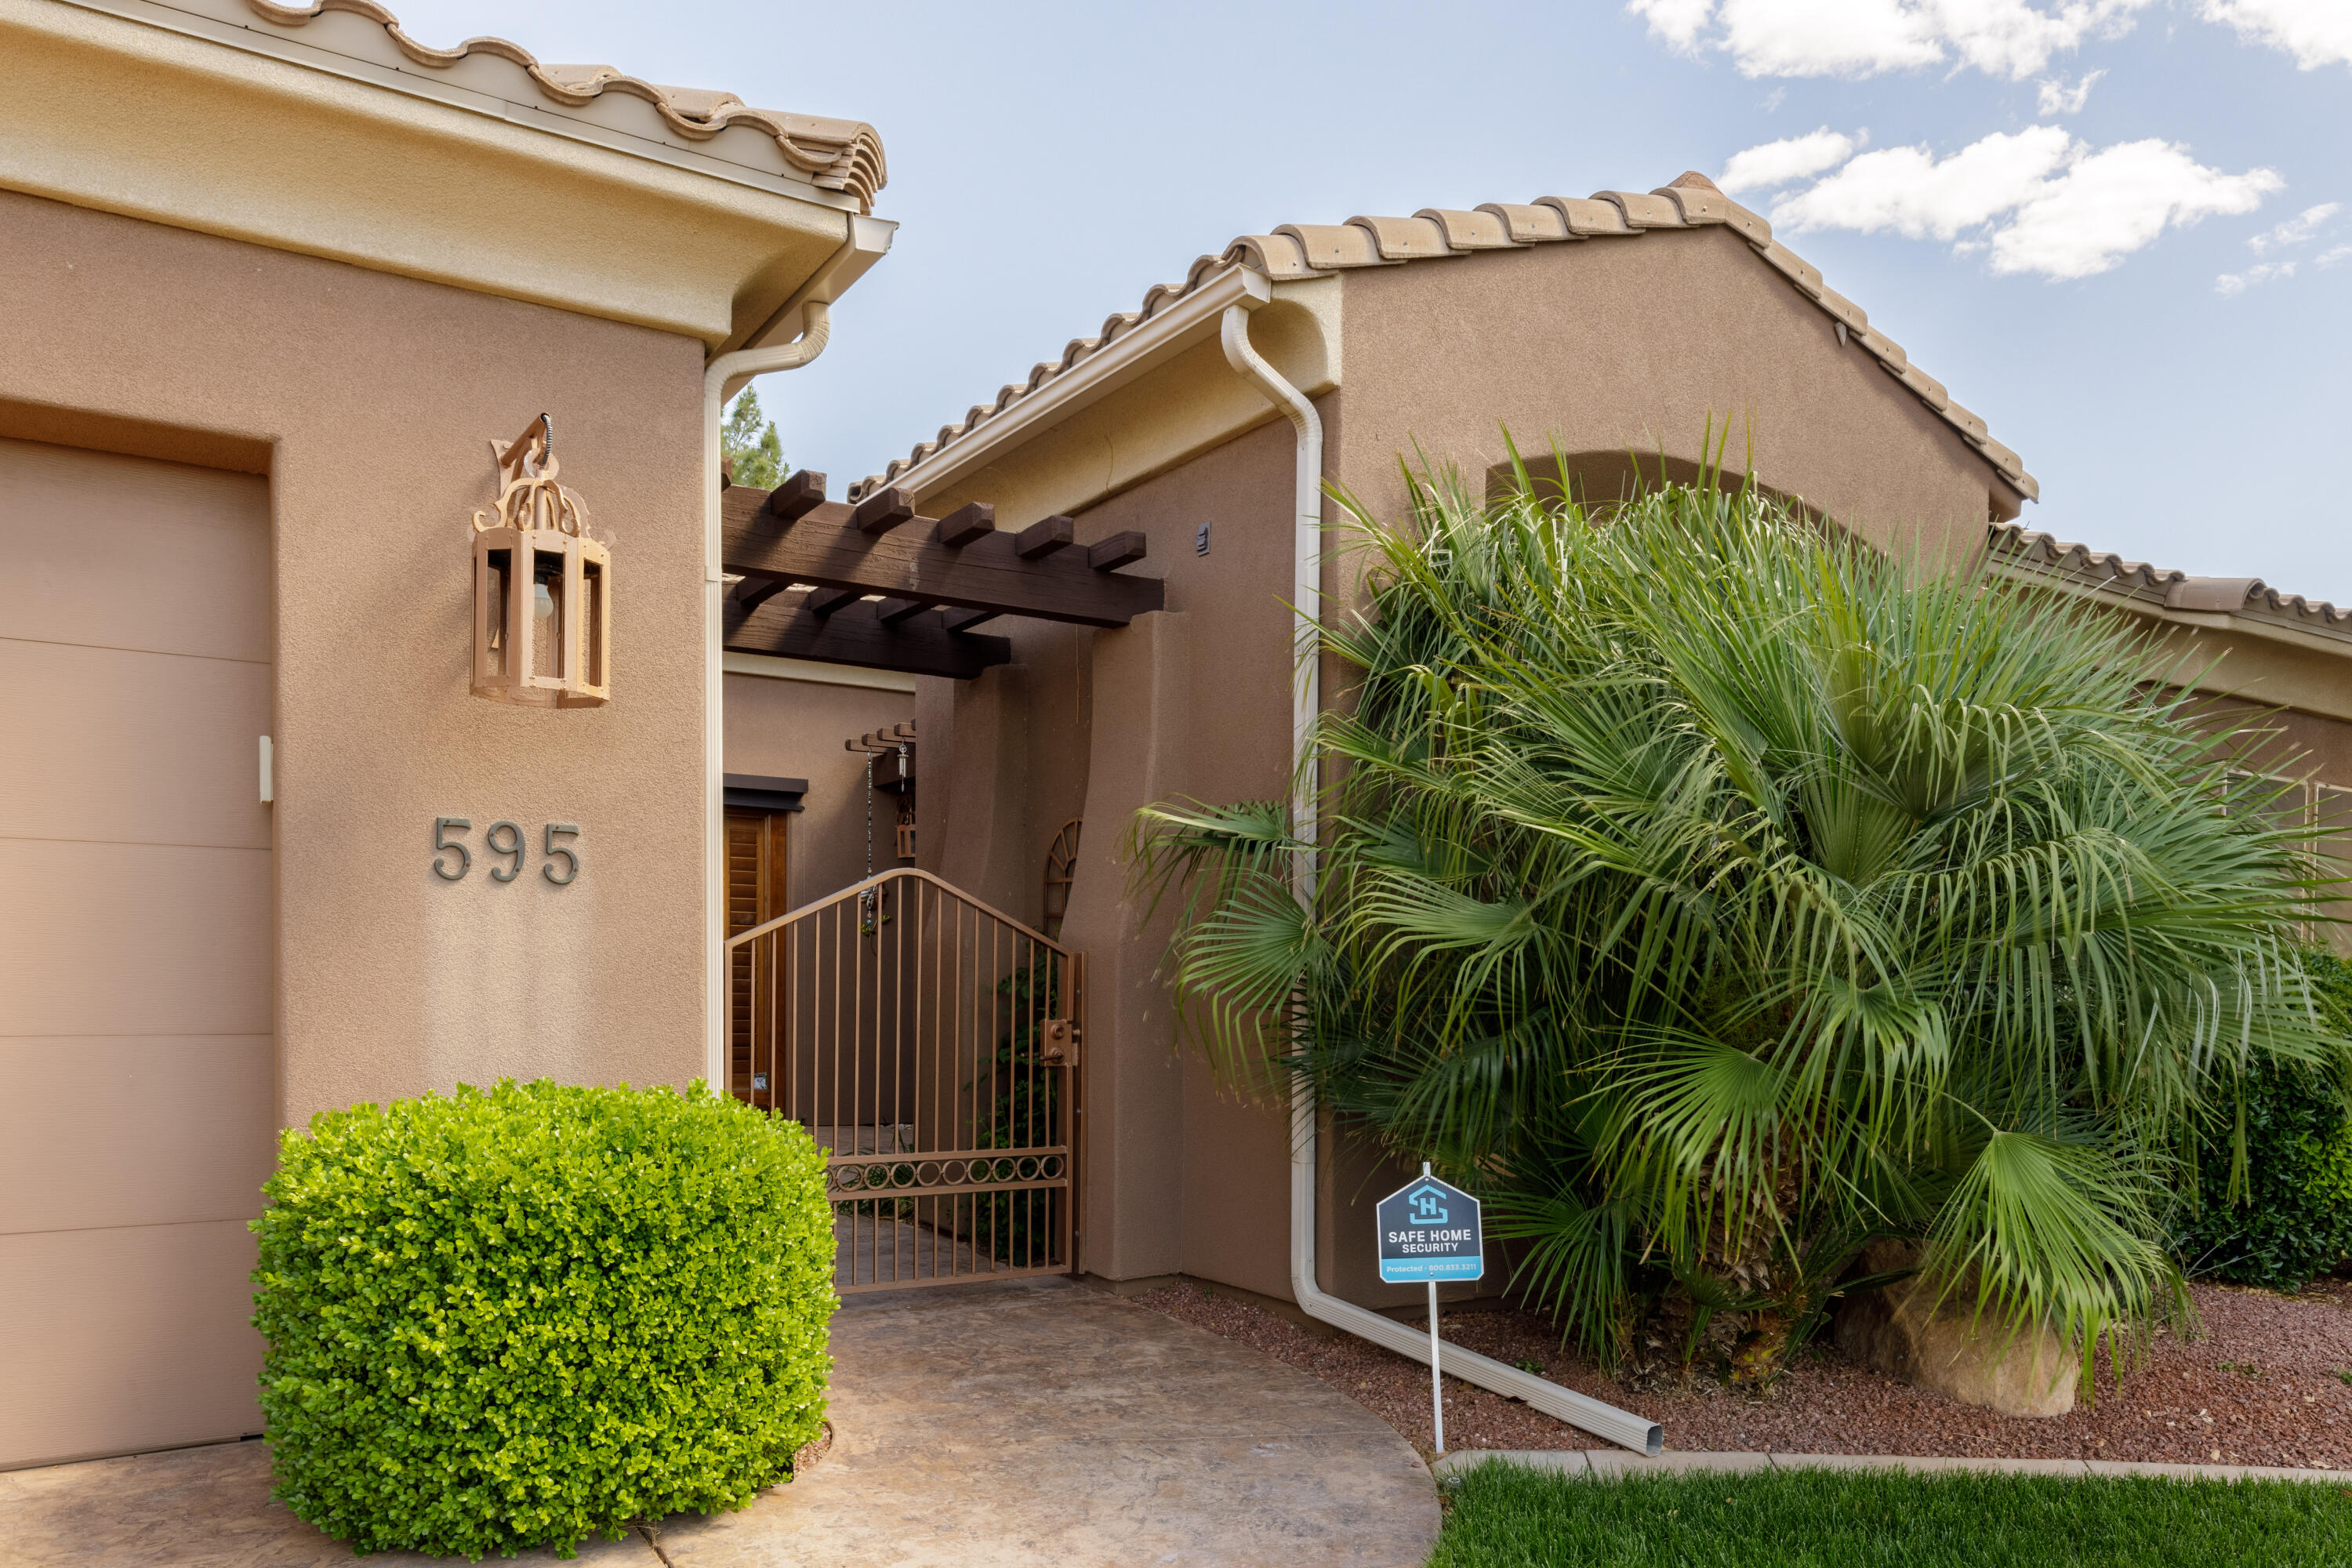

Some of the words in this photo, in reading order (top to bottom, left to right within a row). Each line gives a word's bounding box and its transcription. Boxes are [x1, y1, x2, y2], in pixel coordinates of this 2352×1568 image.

[434, 817, 579, 885] 595
[1388, 1231, 1425, 1243] SAFE
[1431, 1229, 1472, 1242] HOME
[1403, 1243, 1458, 1254] SECURITY
